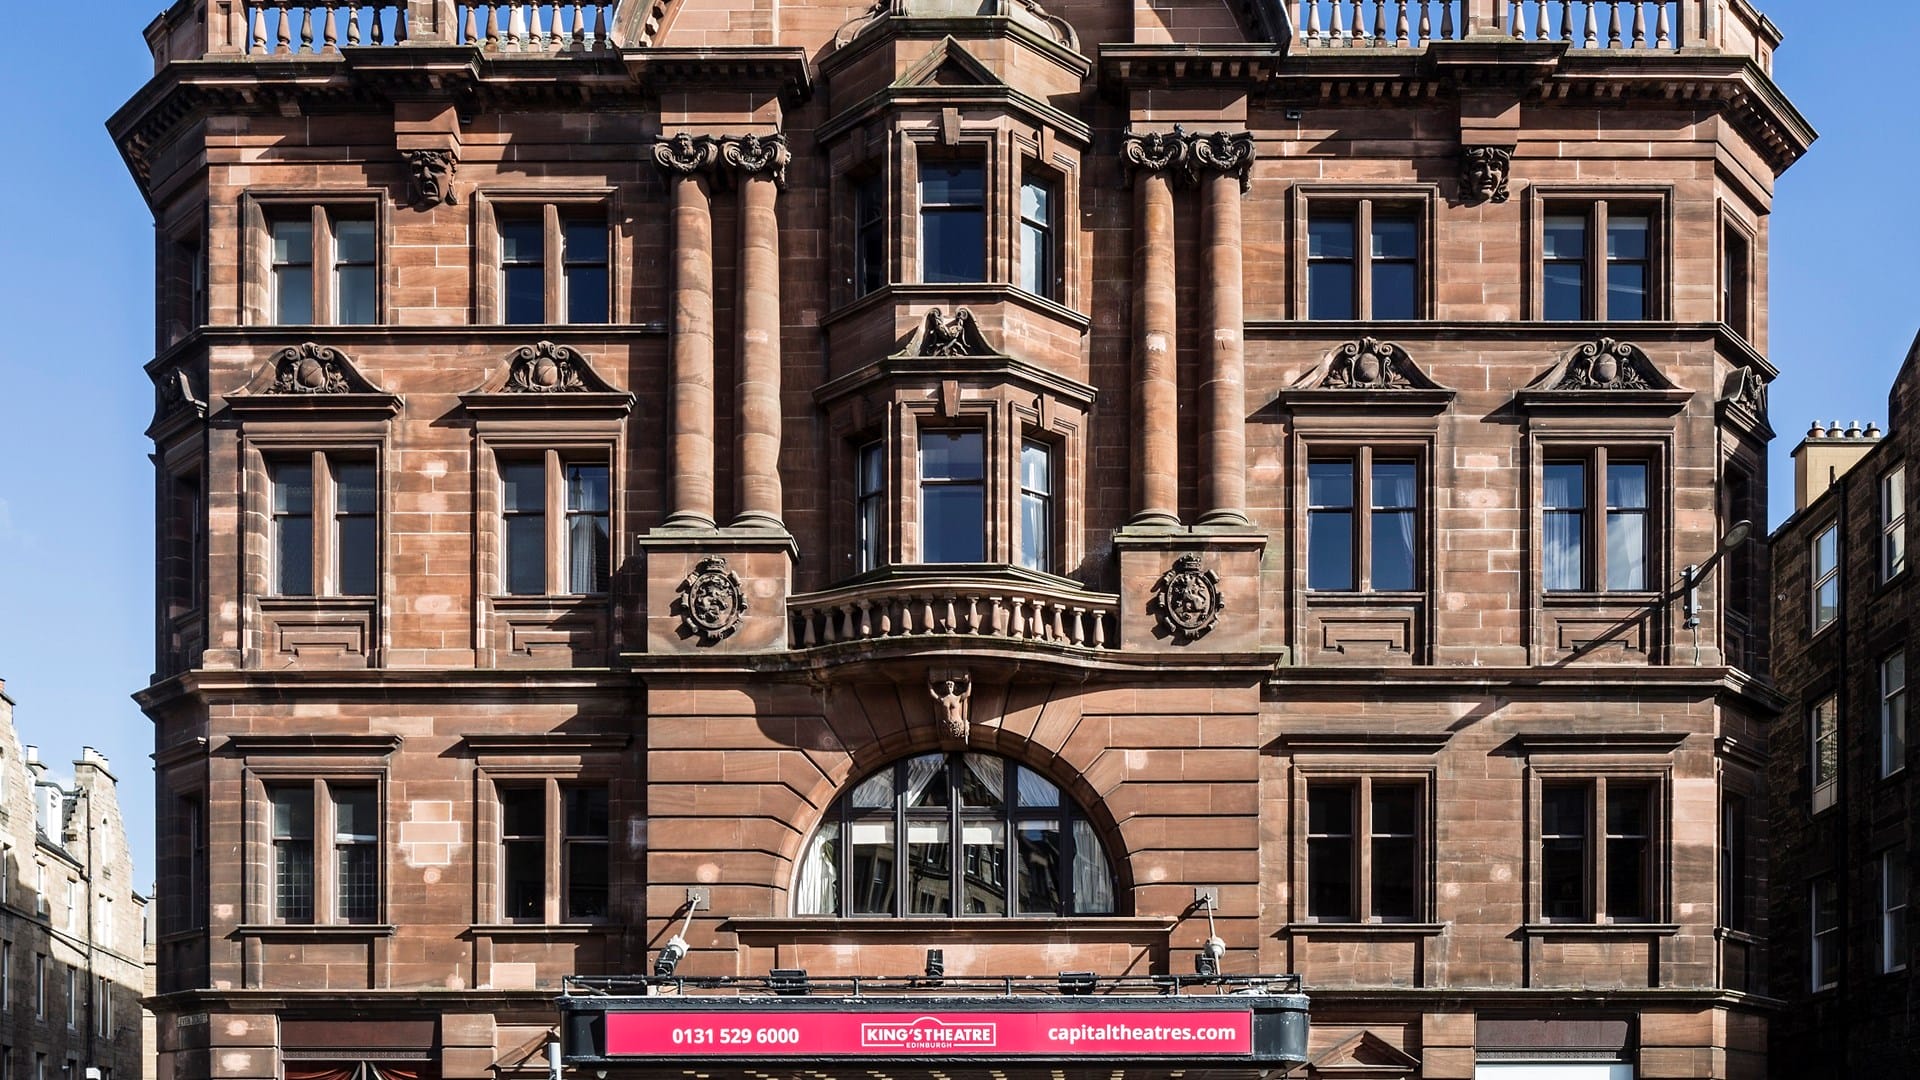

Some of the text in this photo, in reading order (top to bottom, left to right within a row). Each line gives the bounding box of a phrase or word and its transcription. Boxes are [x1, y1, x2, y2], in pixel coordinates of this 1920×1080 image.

[672, 1027, 798, 1043] 0131 529 6000
[867, 1028, 990, 1041] KING'S THEATRE
[1047, 1024, 1236, 1044] capitaltheatres.com
